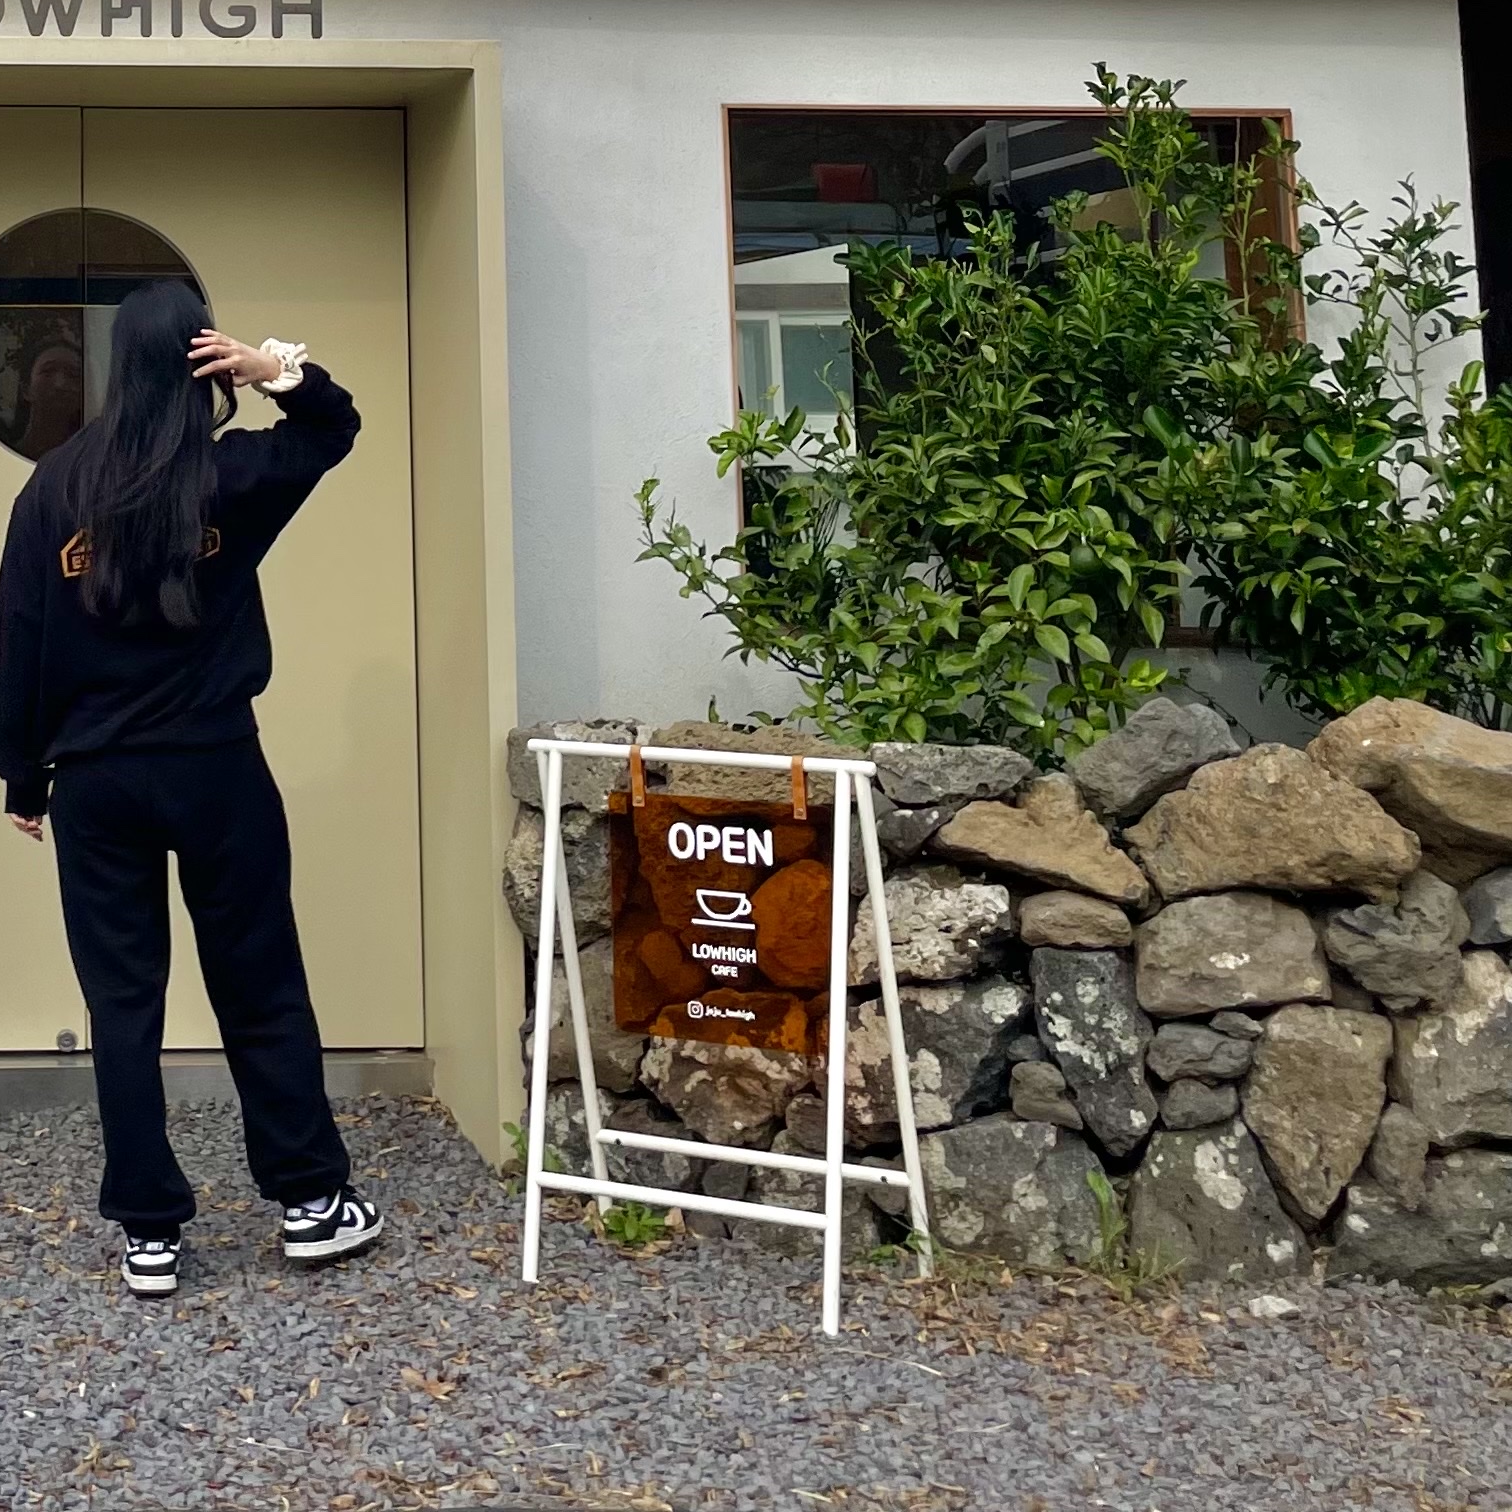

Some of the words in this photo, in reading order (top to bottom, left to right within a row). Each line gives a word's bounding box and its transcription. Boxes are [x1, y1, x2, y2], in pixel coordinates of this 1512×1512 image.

[668, 822, 774, 866] OPEN
[692, 943, 757, 964] LOWHIGH
[711, 964, 738, 977] CAFE
